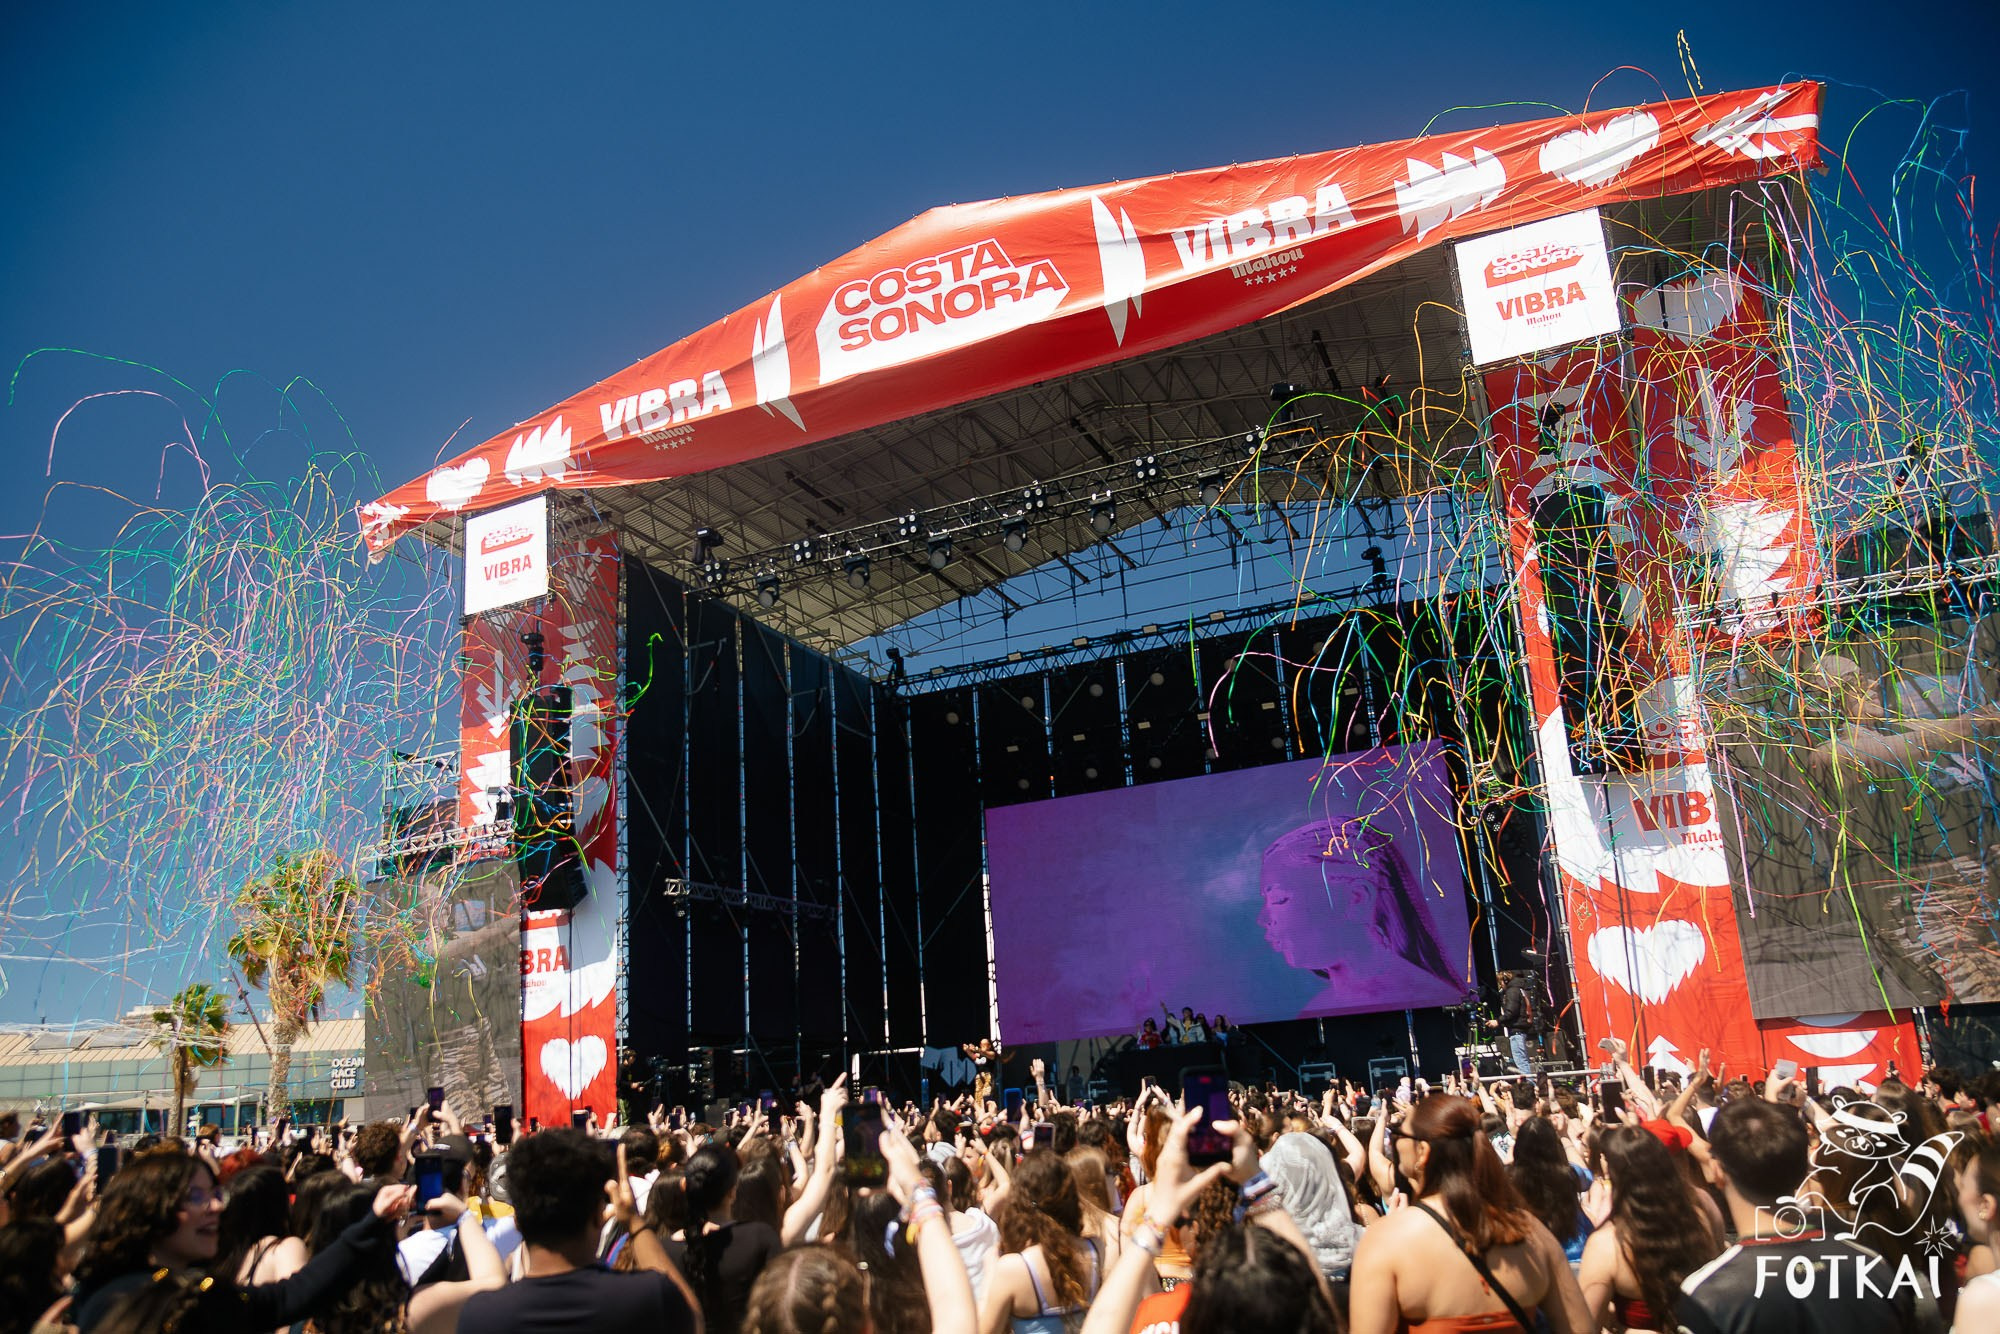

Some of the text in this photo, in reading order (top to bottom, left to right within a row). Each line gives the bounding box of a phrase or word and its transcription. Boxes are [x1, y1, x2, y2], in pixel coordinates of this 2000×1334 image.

[1171, 183, 1357, 271] VIBRA
[1229, 248, 1305, 279] Mahou
[1491, 240, 1563, 267] COSTA
[1492, 246, 1584, 279] SONORA
[835, 240, 1011, 316] COSTA
[838, 261, 1066, 352] SONORA
[1496, 281, 1587, 321] VIBRA
[599, 369, 733, 441] VIBRA
[637, 424, 696, 445] Mahou
[484, 554, 532, 581] VIBRA
[1632, 791, 1720, 832] VIB
[331, 1056, 366, 1068] OCEAN
[331, 1067, 357, 1079] RACE
[330, 1078, 356, 1089] CLUB
